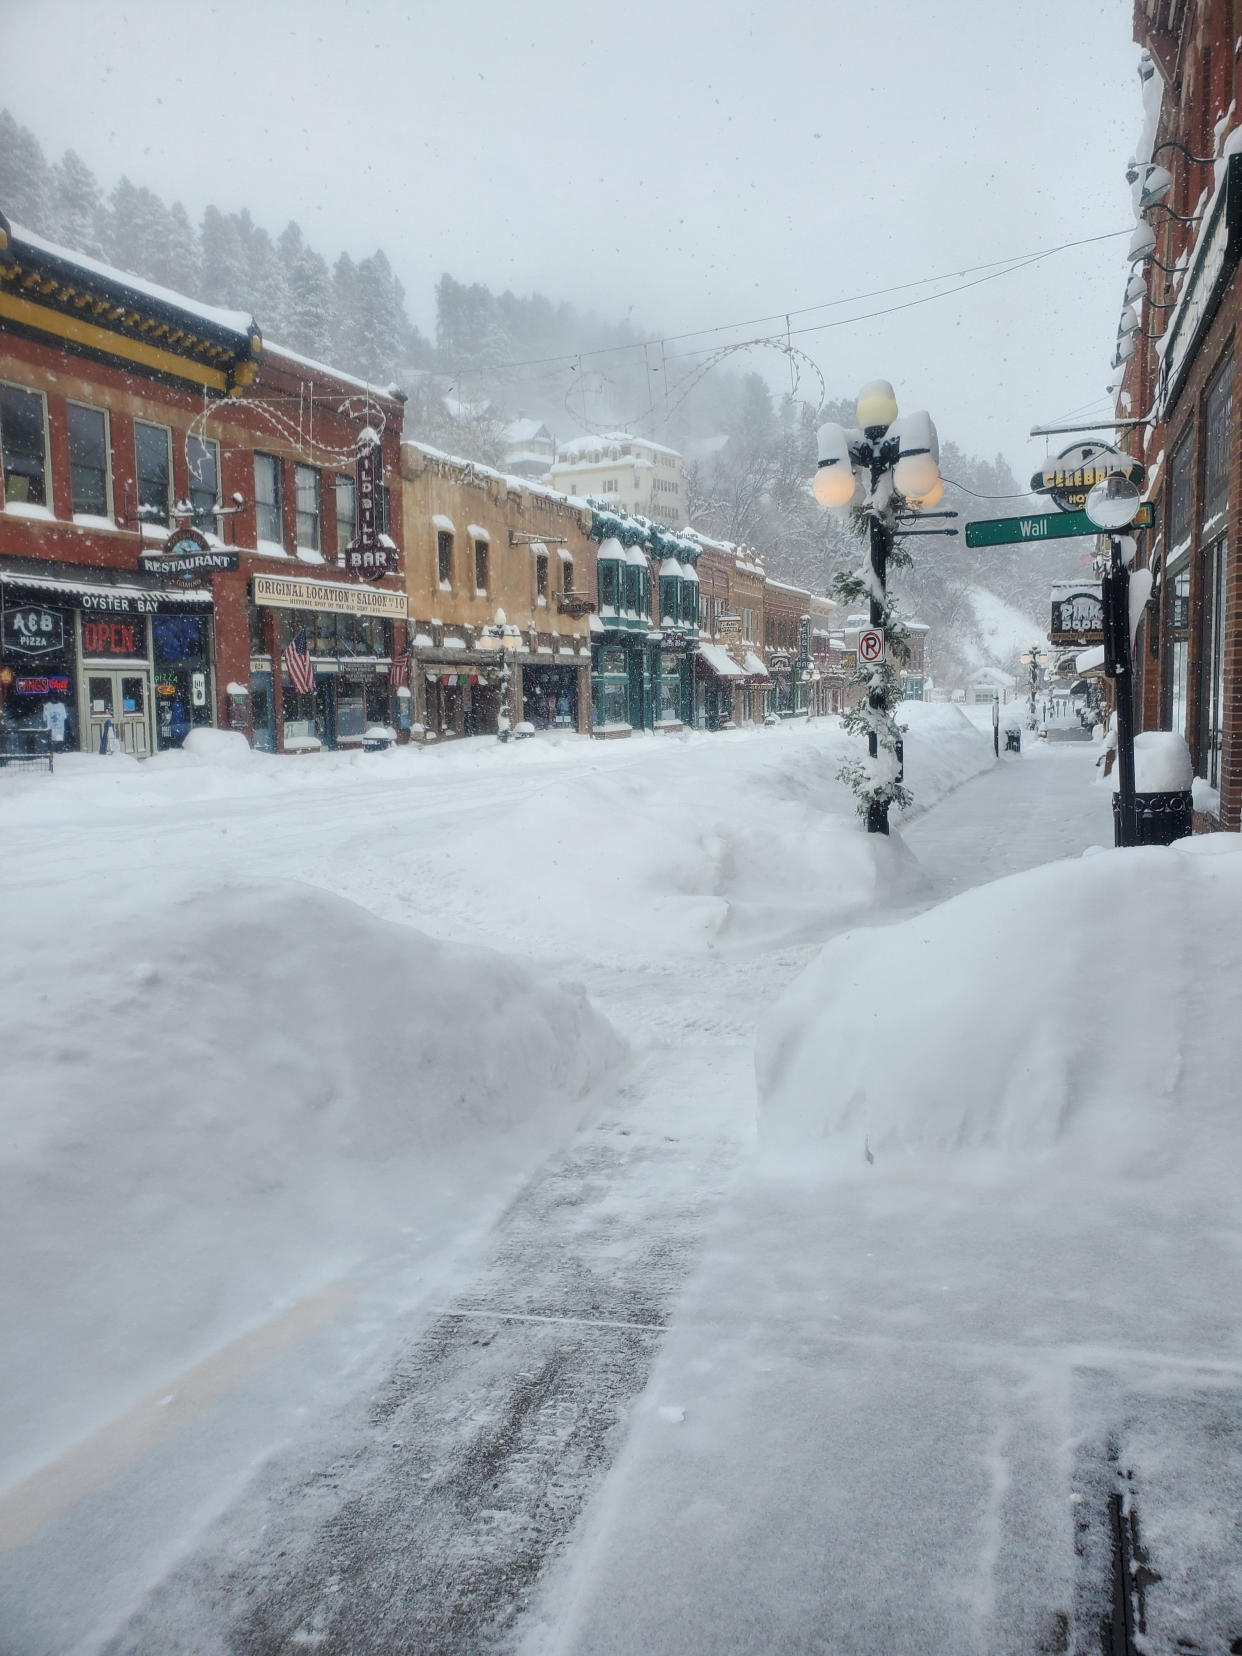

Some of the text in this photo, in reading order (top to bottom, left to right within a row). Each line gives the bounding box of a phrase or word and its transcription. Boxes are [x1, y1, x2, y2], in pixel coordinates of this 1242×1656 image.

[1043, 466, 1133, 488] CELEBRY
[362, 499, 373, 545] BILL
[1019, 519, 1048, 537] Wall
[144, 555, 229, 573] RESTAURANT
[351, 551, 387, 567] BAR
[257, 579, 303, 598] ORIGINAL
[306, 585, 350, 604] LOCATION
[356, 592, 387, 607] SALOON
[395, 597, 405, 609] 10
[83, 596, 159, 615] OYSTER BAY
[1061, 620, 1103, 630] DOOR
[20, 636, 47, 646] PIZZA
[84, 622, 134, 652] OPEN
